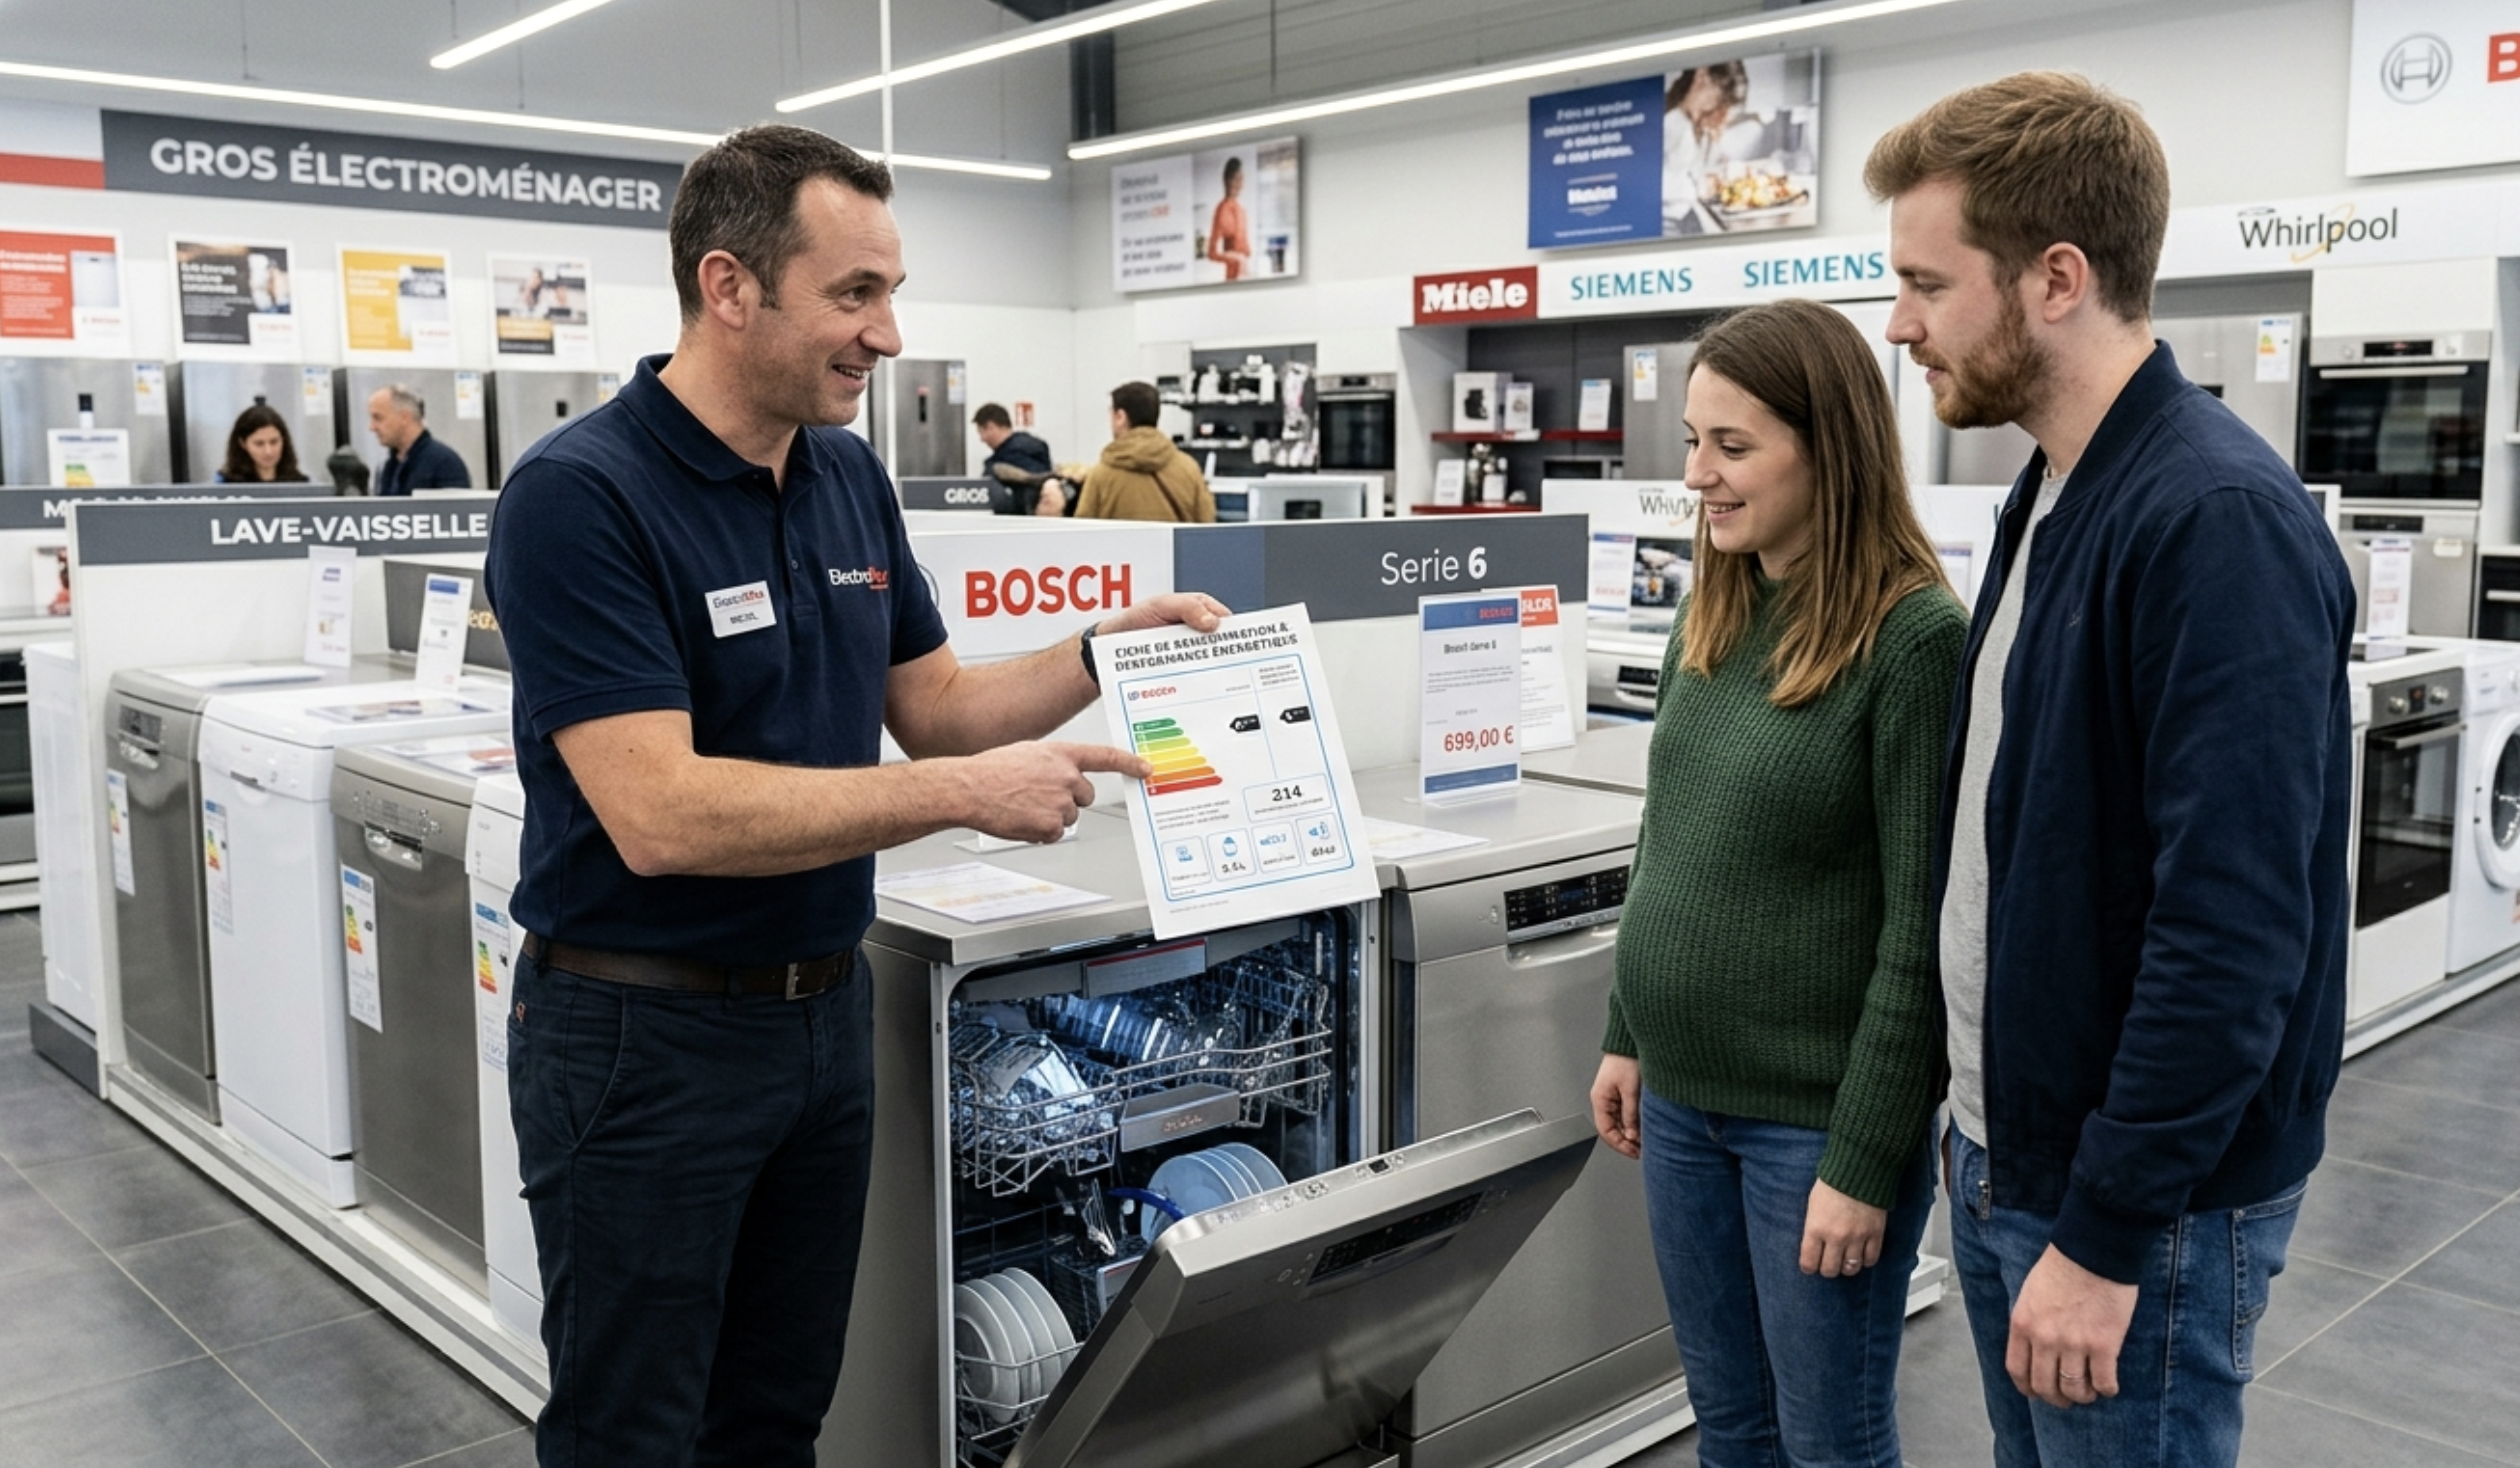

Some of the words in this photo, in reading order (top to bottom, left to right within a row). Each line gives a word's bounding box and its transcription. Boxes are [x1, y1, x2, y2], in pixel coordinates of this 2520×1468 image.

[150, 138, 277, 181] GROS
[289, 143, 663, 212] ÉLECTROMÉNAGER
[2239, 207, 2397, 253] Whirlpool
[1570, 267, 1692, 300] SIEMENS
[1744, 252, 1885, 288] SIEMENS
[1422, 278, 1528, 314] Miele
[210, 513, 488, 545] LAVE-VAISSELLE
[1380, 550, 1460, 586] Serie
[1468, 547, 1488, 580] 6
[964, 563, 1132, 618] BOSCH
[1444, 727, 1500, 752] 699,00
[1503, 725, 1515, 745] €
